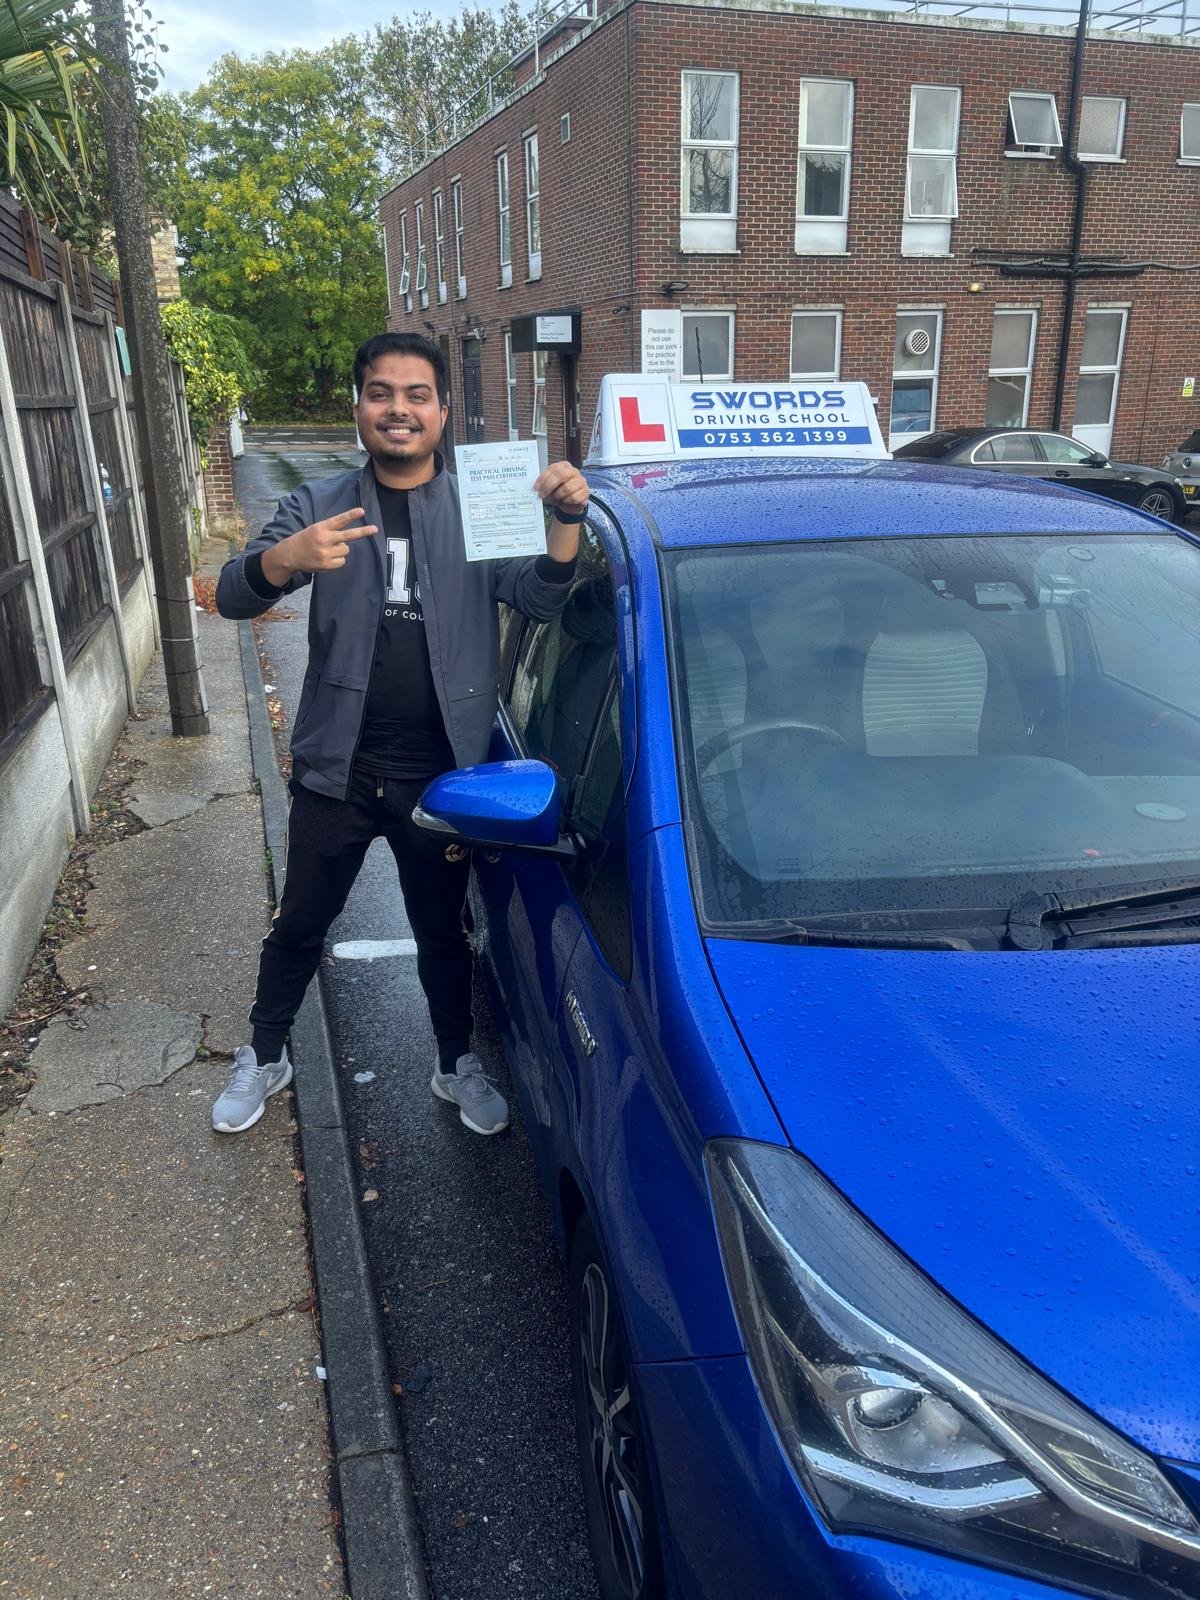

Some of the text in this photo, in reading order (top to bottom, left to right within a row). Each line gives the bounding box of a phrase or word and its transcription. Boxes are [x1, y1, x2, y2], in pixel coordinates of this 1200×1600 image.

[690, 390, 846, 410] SWORDS
[618, 396, 667, 443] L
[694, 413, 850, 425] DRIVING SCHOOL
[704, 430, 847, 444] 0753 362 1399
[469, 465, 528, 476] PRACTICAL DRIVING
[496, 471, 528, 480] CERTIFICATE
[385, 609, 398, 617] OF
